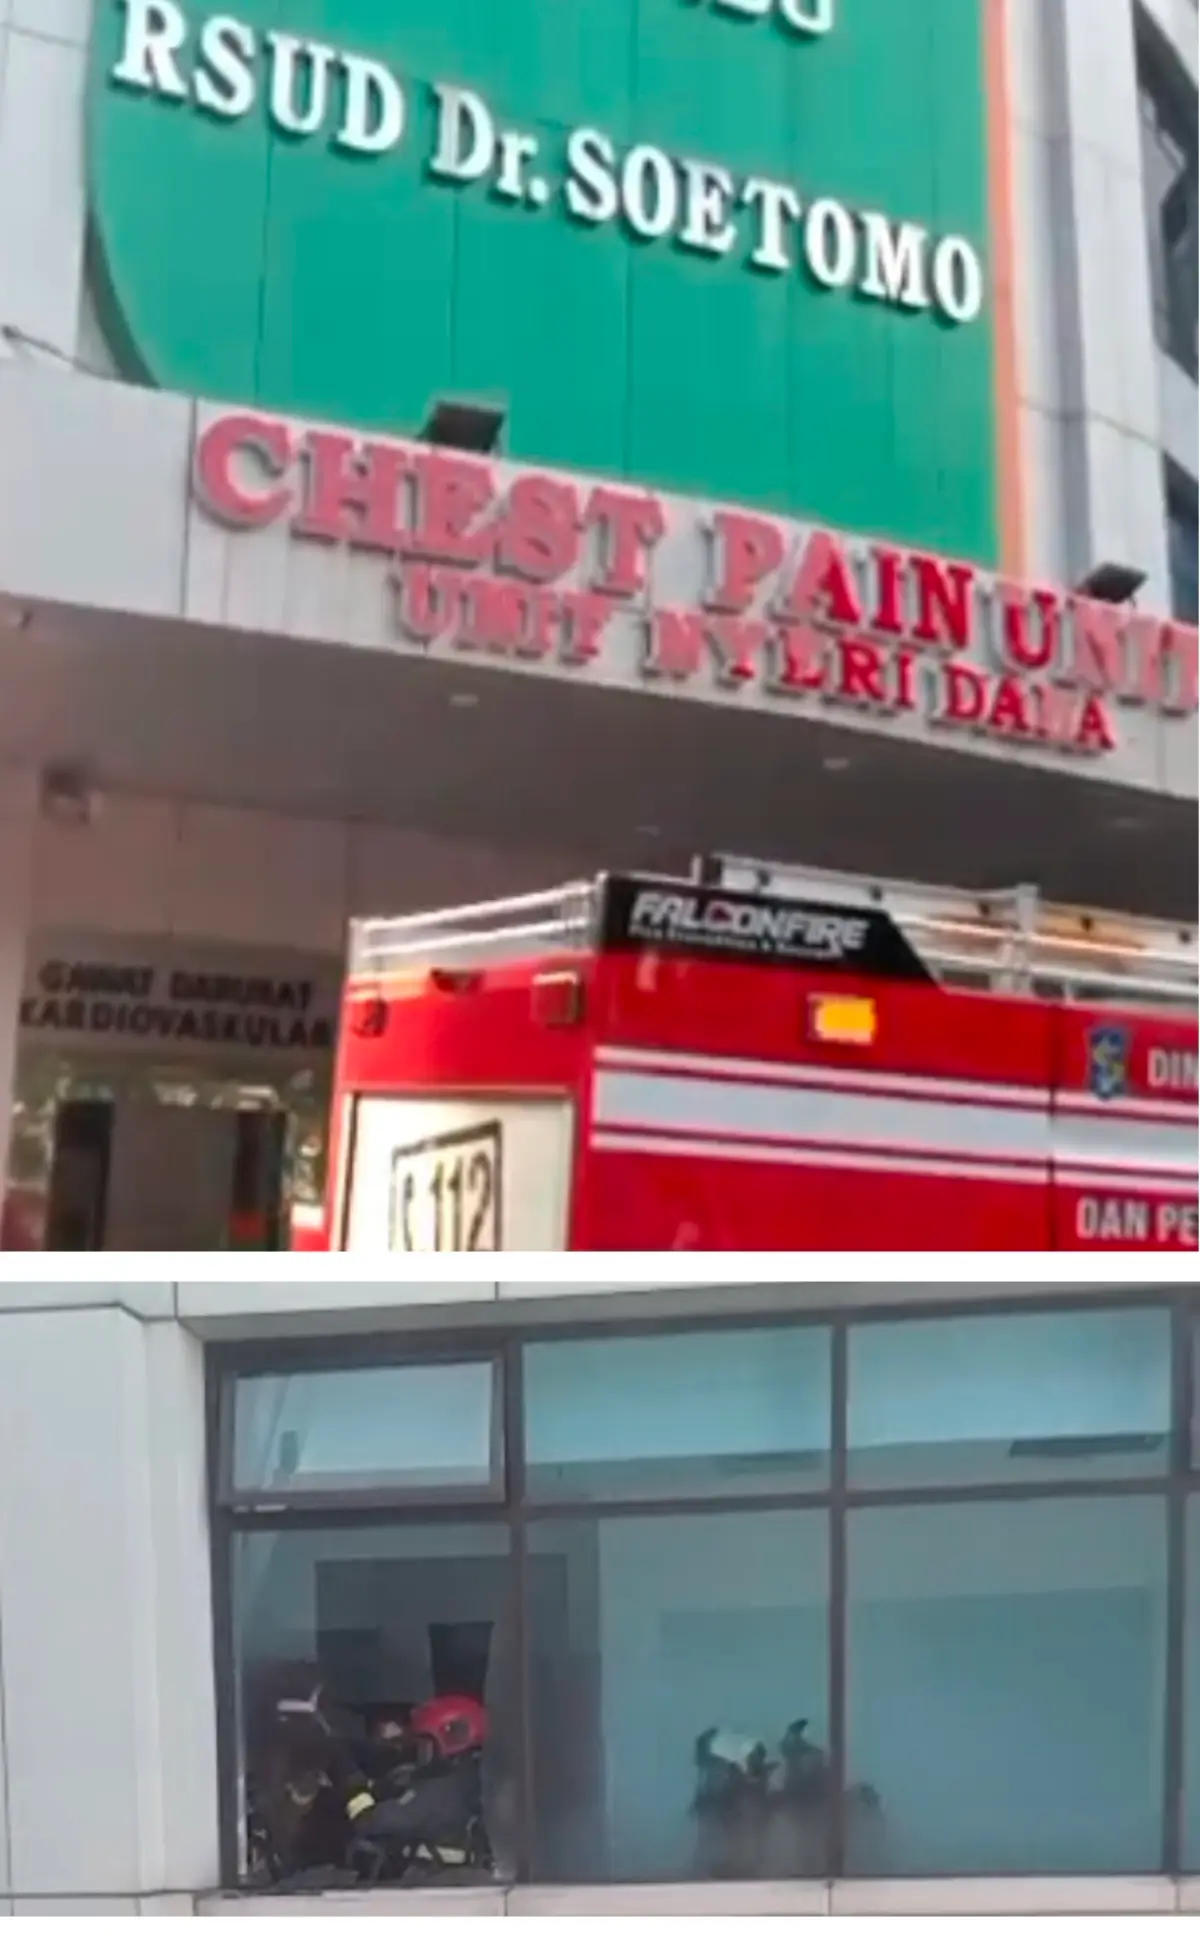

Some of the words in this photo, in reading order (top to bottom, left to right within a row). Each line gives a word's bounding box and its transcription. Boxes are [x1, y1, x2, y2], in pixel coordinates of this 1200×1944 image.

[113, 0, 404, 152] RSUD
[430, 82, 550, 204] Dr.
[565, 127, 983, 324] SOETOMO
[194, 411, 668, 590] CHEST
[703, 510, 976, 652] PAIN
[992, 576, 1198, 712] UNIT
[398, 562, 614, 660] UNIT
[646, 607, 918, 712] NYERI
[629, 890, 870, 956] FALCONFIRE
[428, 1150, 493, 1251] 112
[1076, 1196, 1149, 1241] DAN
